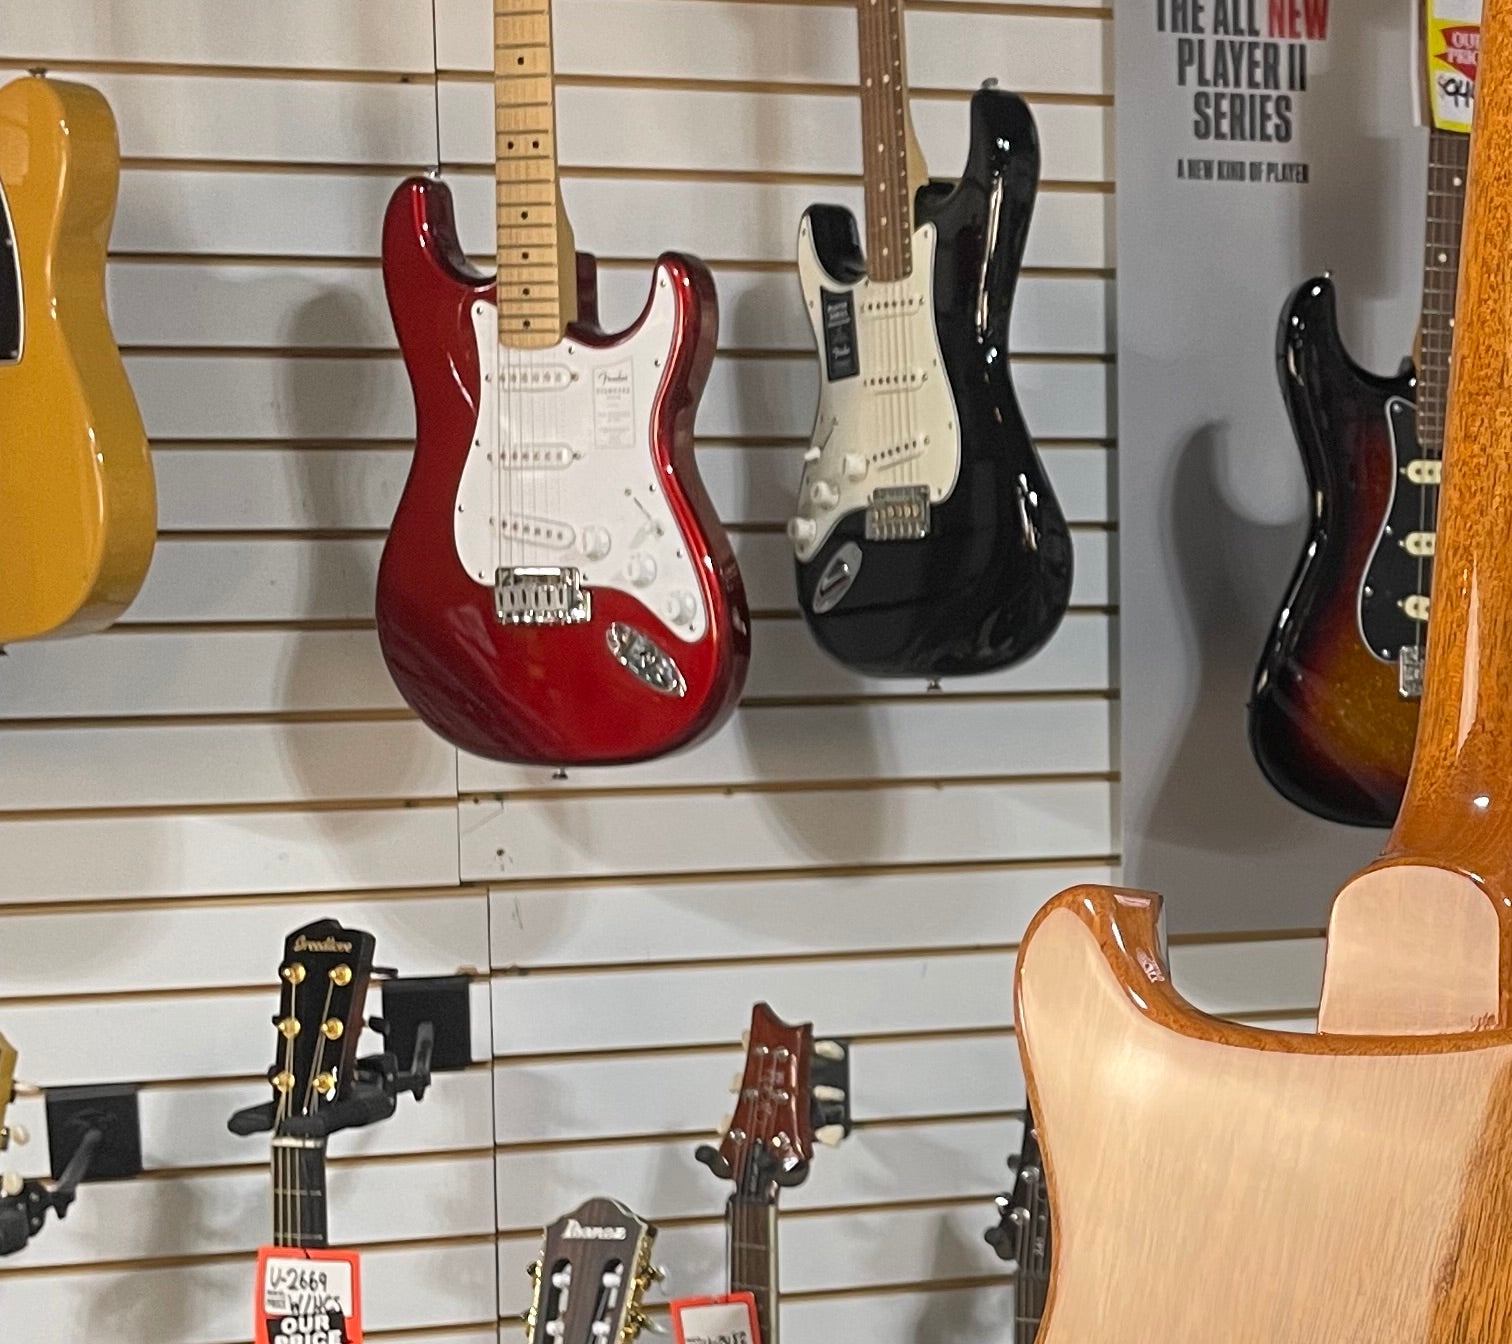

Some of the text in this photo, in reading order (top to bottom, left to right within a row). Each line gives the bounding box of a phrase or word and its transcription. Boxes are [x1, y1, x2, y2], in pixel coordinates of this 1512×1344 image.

[1177, 37, 1308, 93] PLAYER II
[1193, 90, 1294, 144] SERIES
[1177, 158, 1186, 180] A
[1187, 158, 1215, 181] NEW
[1249, 161, 1265, 183] OF
[1266, 162, 1310, 184] PLAYER
[280, 1314, 330, 1336] OUR
